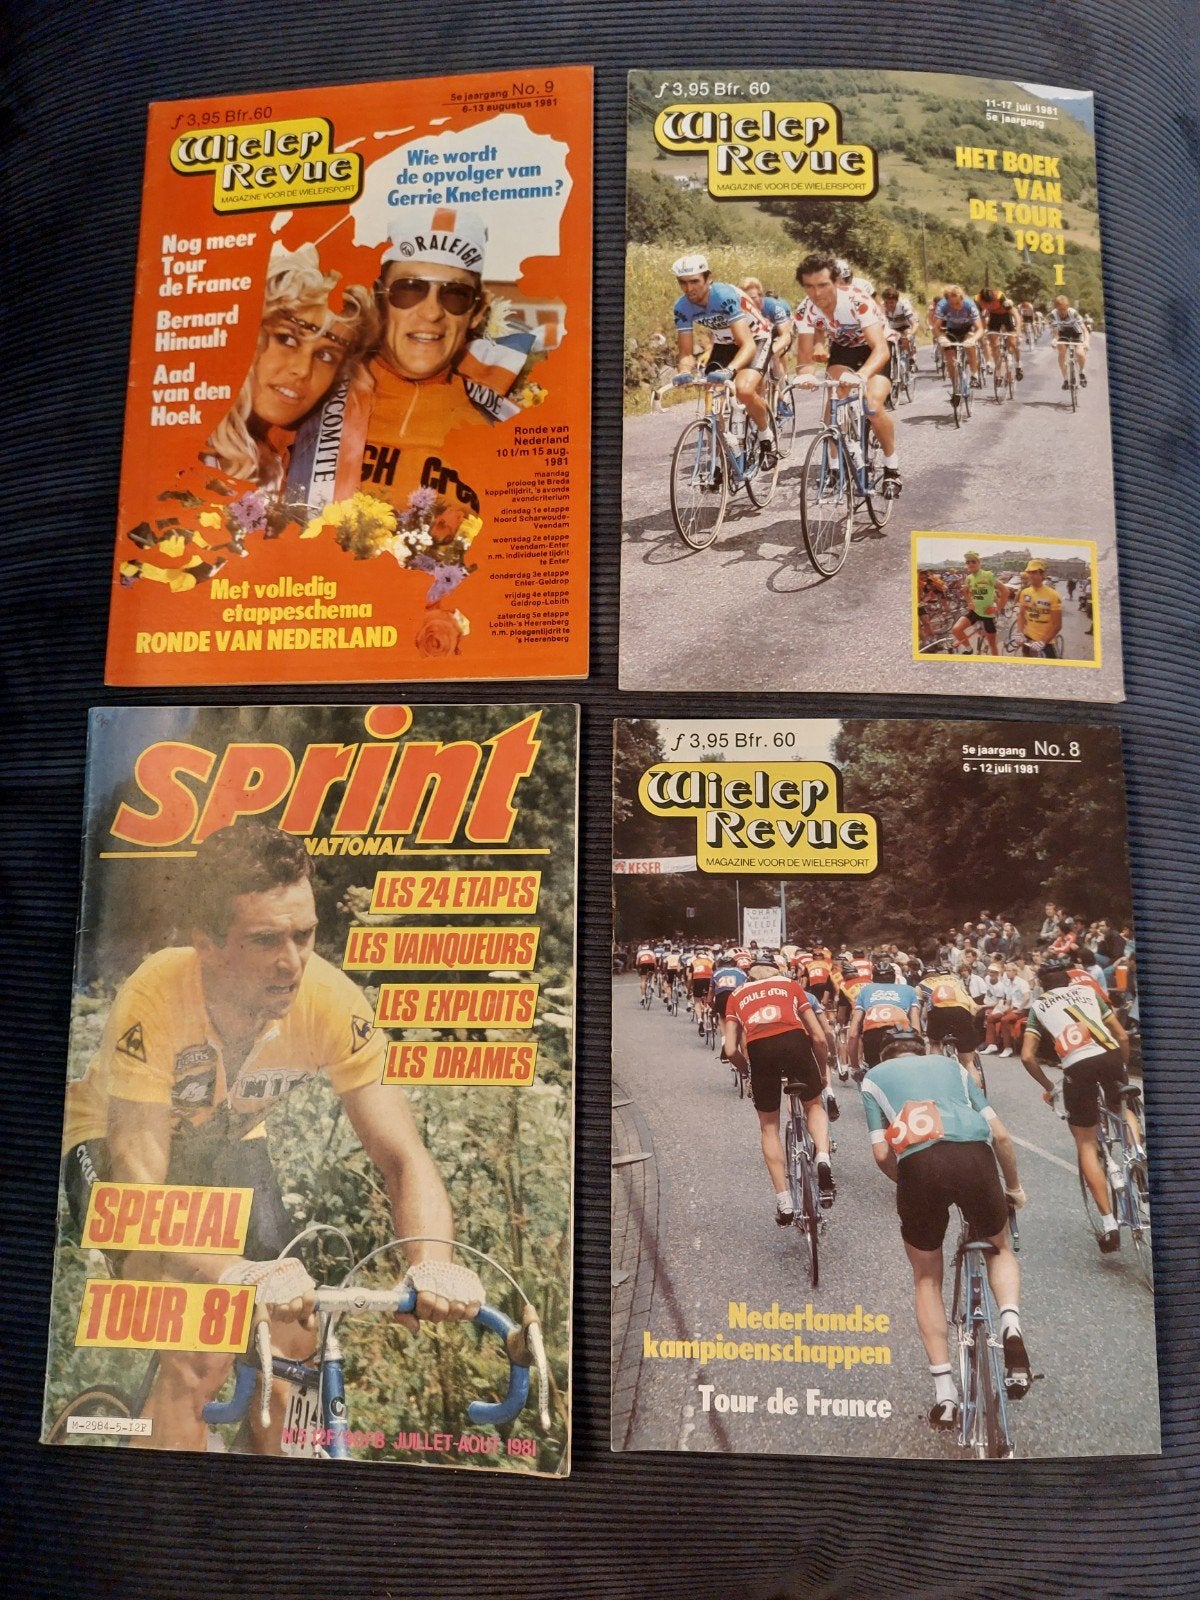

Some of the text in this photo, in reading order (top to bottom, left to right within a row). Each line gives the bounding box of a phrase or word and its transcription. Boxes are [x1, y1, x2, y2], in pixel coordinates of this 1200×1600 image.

[451, 80, 554, 102] 5e jaargang No. 9
[672, 82, 770, 98] 3,95 Bfr. 60
[462, 98, 558, 113] 6-13 augustus 1981
[985, 99, 1058, 115] 11-17 juli 1981
[187, 111, 220, 127] 3,95
[662, 109, 830, 147] Wieler
[986, 112, 1045, 129] 5e jaargang
[178, 129, 322, 163] Wieler
[407, 145, 498, 166] Wie wordt
[716, 144, 866, 175] Revue
[955, 146, 1060, 178] HET BOEK
[222, 158, 353, 191] Revue
[396, 165, 541, 186] de opvolger van
[221, 184, 355, 204] MAGAZINE VOOR DE WIELERSPORT
[387, 179, 564, 206] Gerrie Knetemann?
[716, 182, 763, 191] MAGAZINE
[764, 182, 790, 190] VOOR
[804, 182, 866, 191] WIELERSPORT
[1013, 178, 1062, 204] VAN
[969, 198, 1063, 229] DE TOUR
[162, 233, 257, 255] Nog meer
[415, 234, 483, 268] RALEIGH
[1014, 229, 1065, 255] 1981
[161, 256, 207, 276] Tour
[1053, 264, 1065, 286] I
[159, 275, 252, 297] de France
[156, 304, 239, 330] Bernard
[155, 328, 228, 352] Hinault
[153, 362, 195, 385] Aad
[152, 381, 231, 403] van den
[151, 404, 202, 426] Hoek
[514, 425, 569, 435] Ronde van
[514, 435, 569, 446] Nederland
[496, 447, 569, 457] 10 t/m 15 aug.
[545, 457, 568, 466] 1981
[506, 480, 536, 488] proloog
[534, 470, 570, 478] maandag
[501, 507, 531, 515] dinsdag
[543, 506, 570, 514] etappe
[543, 534, 570, 542] etappe
[506, 551, 548, 559] individuele
[549, 550, 569, 558] tijdrit
[490, 572, 531, 580] donderdag
[543, 570, 569, 578] etappe
[210, 575, 337, 599] Met volledig
[504, 591, 531, 599] vrijdag
[543, 590, 569, 598] etappe
[222, 599, 373, 625] etappeschema
[497, 612, 531, 620] zaterdag
[524, 619, 569, 627] Heerenberg
[136, 626, 398, 654] RONDE VAN NEDERLAND
[524, 635, 569, 643] Heerenberg
[690, 732, 796, 750] 3,95 Bfr. 60
[962, 741, 1080, 758] 5e jaargang No. 8
[962, 763, 1040, 775] 6 12 juli 1981
[646, 770, 829, 817] Wieler
[706, 810, 869, 849] Revue
[706, 857, 869, 868] MAGAZINE VOOR DE WIELERSPORT
[374, 876, 537, 908] LES 24 ETAPES
[347, 932, 535, 969] LES VAINQUEURS
[378, 989, 535, 1022] LES EXPLOITS
[739, 990, 767, 1010] BOULE
[1059, 1025, 1083, 1051] 16
[386, 1045, 533, 1080] LES DRAMES
[88, 1187, 242, 1249] SPECIAL
[86, 1284, 250, 1345] TOUR 81
[728, 1302, 890, 1333] Nederlandse
[643, 1331, 891, 1369] kampioenschappen
[698, 1385, 892, 1418] Tour de France
[394, 1431, 501, 1455] JUILLET-AOUT
[507, 1437, 537, 1457] 1981
